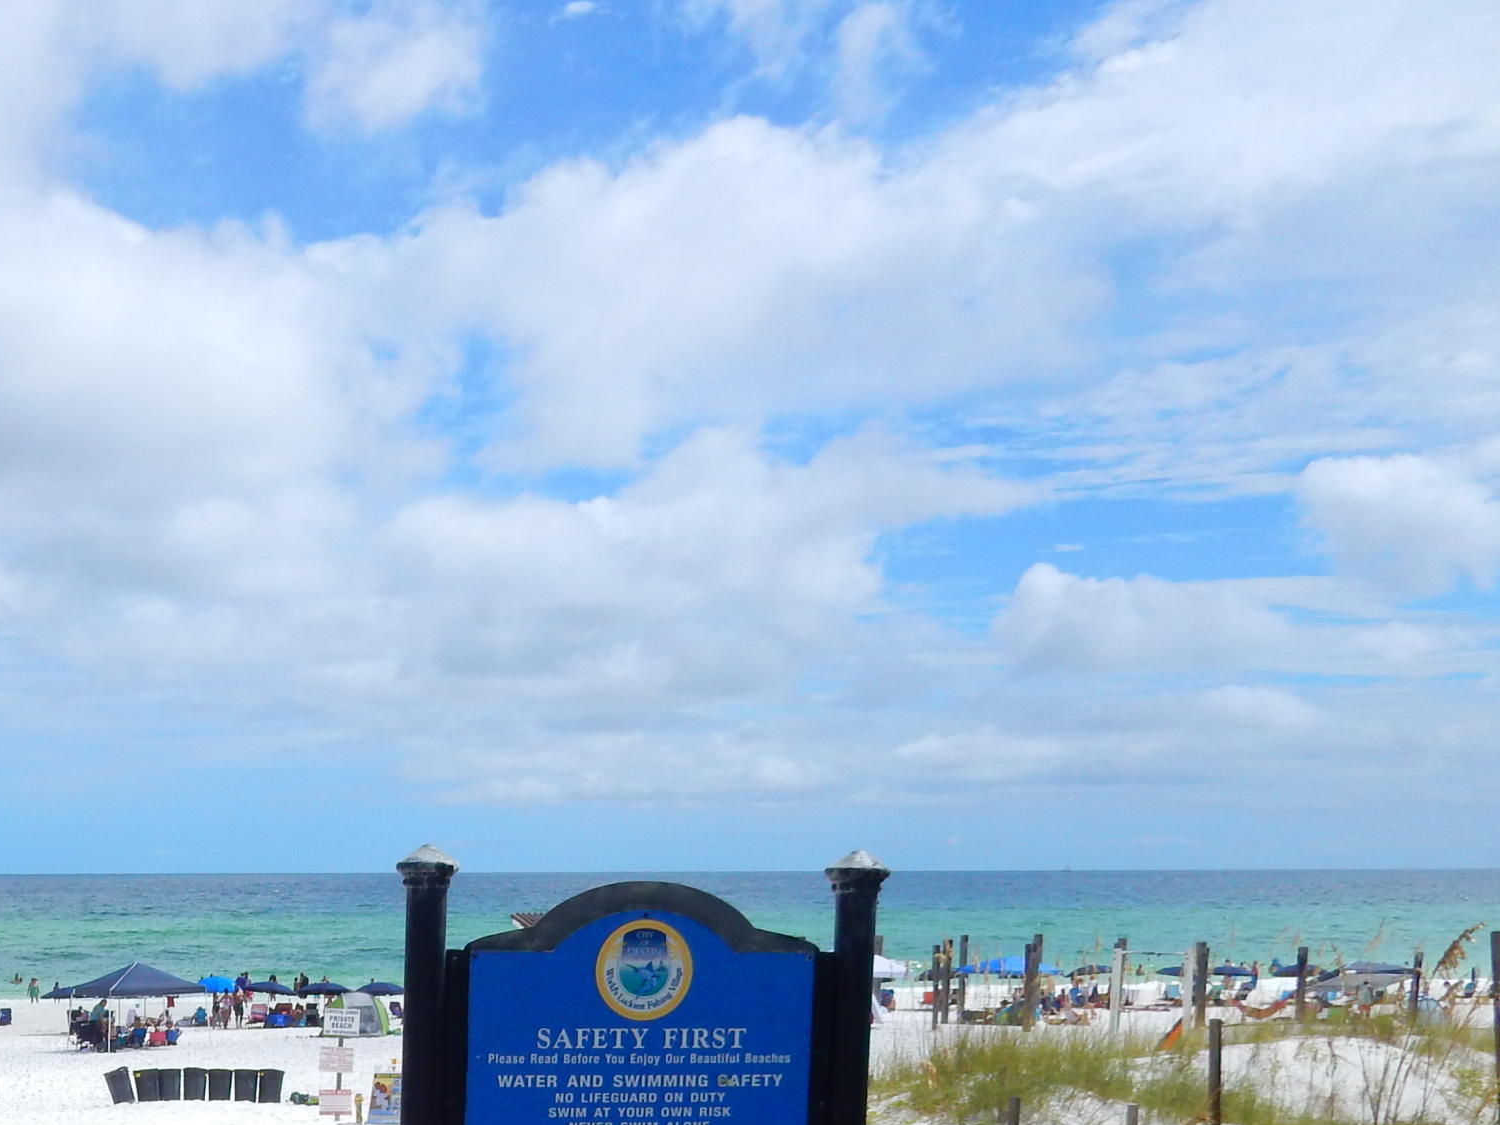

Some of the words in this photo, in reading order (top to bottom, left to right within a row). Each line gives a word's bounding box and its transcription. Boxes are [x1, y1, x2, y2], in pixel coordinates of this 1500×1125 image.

[537, 1028, 647, 1048] SAFETY
[663, 1028, 746, 1048] FIRST
[488, 1053, 524, 1063] Please
[530, 1053, 557, 1063] Read
[563, 1053, 599, 1064] Before
[605, 1053, 624, 1063] You
[630, 1053, 660, 1065] Enjoy
[665, 1053, 684, 1063] Our
[690, 1053, 739, 1063] Beautiful
[745, 1053, 790, 1062] Beaches
[498, 1074, 557, 1087] WATER
[567, 1075, 602, 1087] AND
[613, 1074, 707, 1087] SWIMMING
[717, 1074, 781, 1086] SAFETY
[555, 1093, 573, 1102] NO
[581, 1092, 656, 1102] LIFEGUARD
[664, 1092, 682, 1102] ON
[690, 1092, 724, 1102] DUTY
[548, 1107, 586, 1117] SWIM
[594, 1107, 610, 1117] AT
[618, 1107, 653, 1117] YOUR
[661, 1107, 692, 1116] OWN
[699, 1106, 730, 1116] RISK
